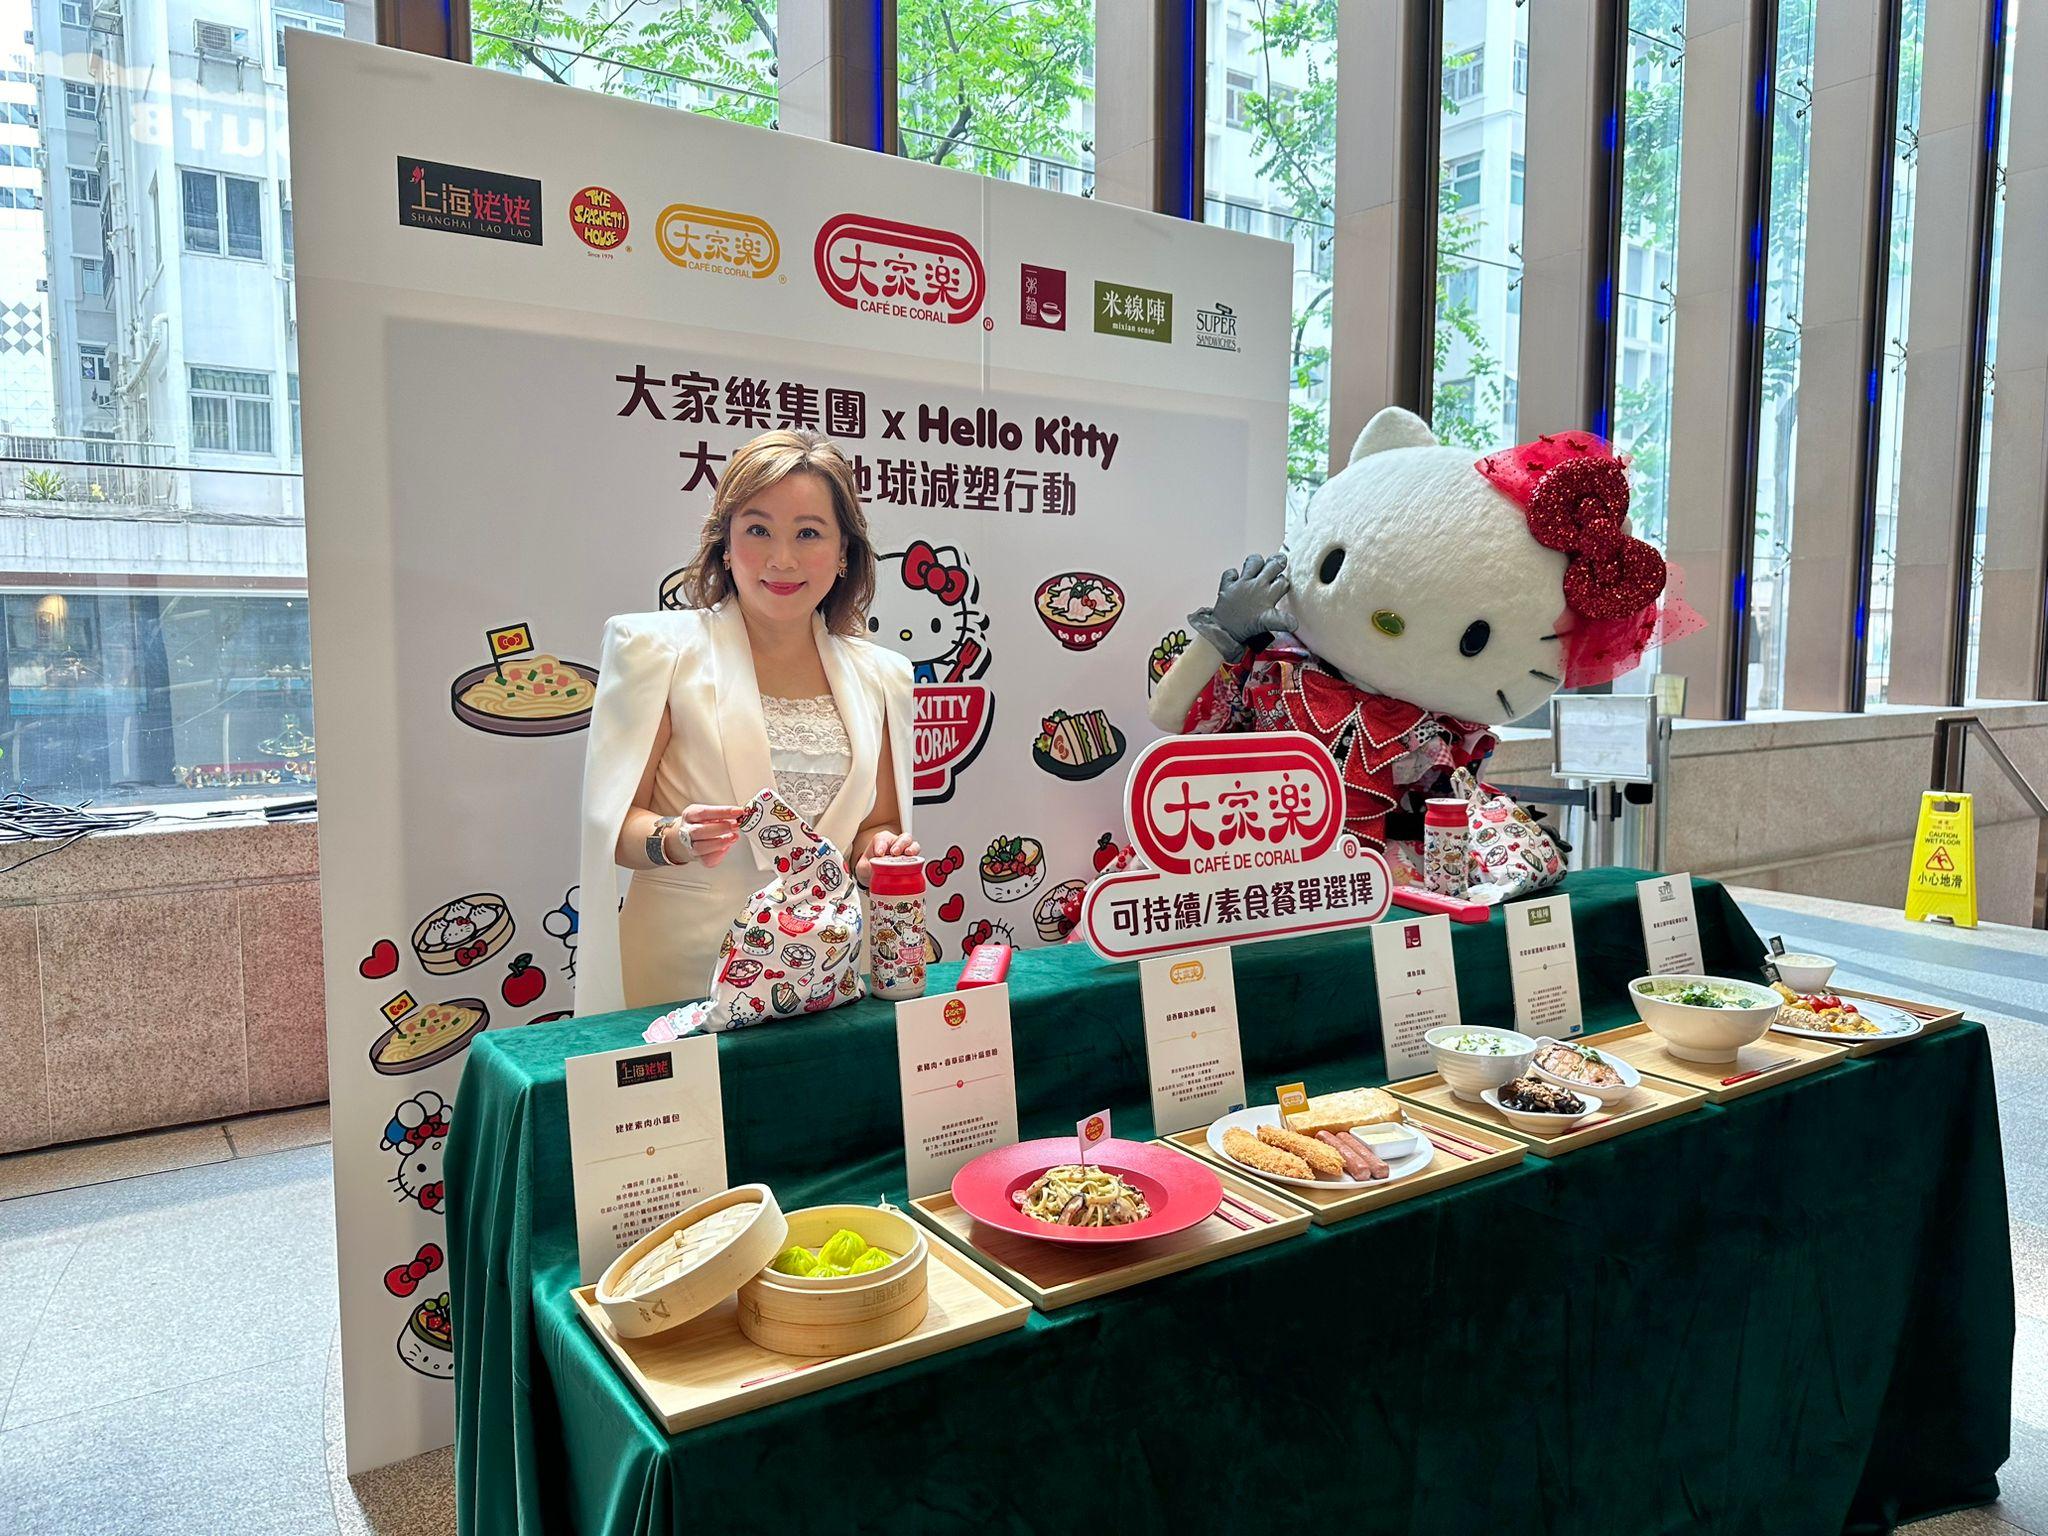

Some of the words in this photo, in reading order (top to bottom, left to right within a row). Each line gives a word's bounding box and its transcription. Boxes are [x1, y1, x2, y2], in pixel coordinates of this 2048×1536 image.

[411, 168, 531, 228] 上海姥姥
[585, 189, 612, 208] THE
[411, 213, 471, 229] SHANGHAI
[480, 223, 502, 234] LAO
[510, 228, 532, 239] LAO
[584, 226, 619, 247] HOUSE
[711, 264, 723, 274] DE
[724, 266, 752, 279] CORAL
[860, 298, 891, 316] CAFÉ
[892, 305, 908, 318] DE
[909, 307, 947, 324] CORAL
[1102, 289, 1166, 326] 米線陣
[1112, 321, 1136, 332] mixian
[1196, 312, 1236, 336] SUPER
[615, 364, 867, 440] 大家樂集團
[881, 409, 906, 442] x
[918, 403, 1023, 451] Hello
[1034, 416, 1120, 471] Kitty
[1928, 831, 1959, 840] CAUTION
[1939, 838, 1961, 846] FLOOR
[1194, 852, 1231, 875] CAFÉ
[1233, 853, 1253, 869] DE
[1254, 848, 1300, 867] CORAL
[1917, 871, 1963, 889] 小心地滑
[1110, 871, 1375, 937] 可持續/素食餐單選擇
